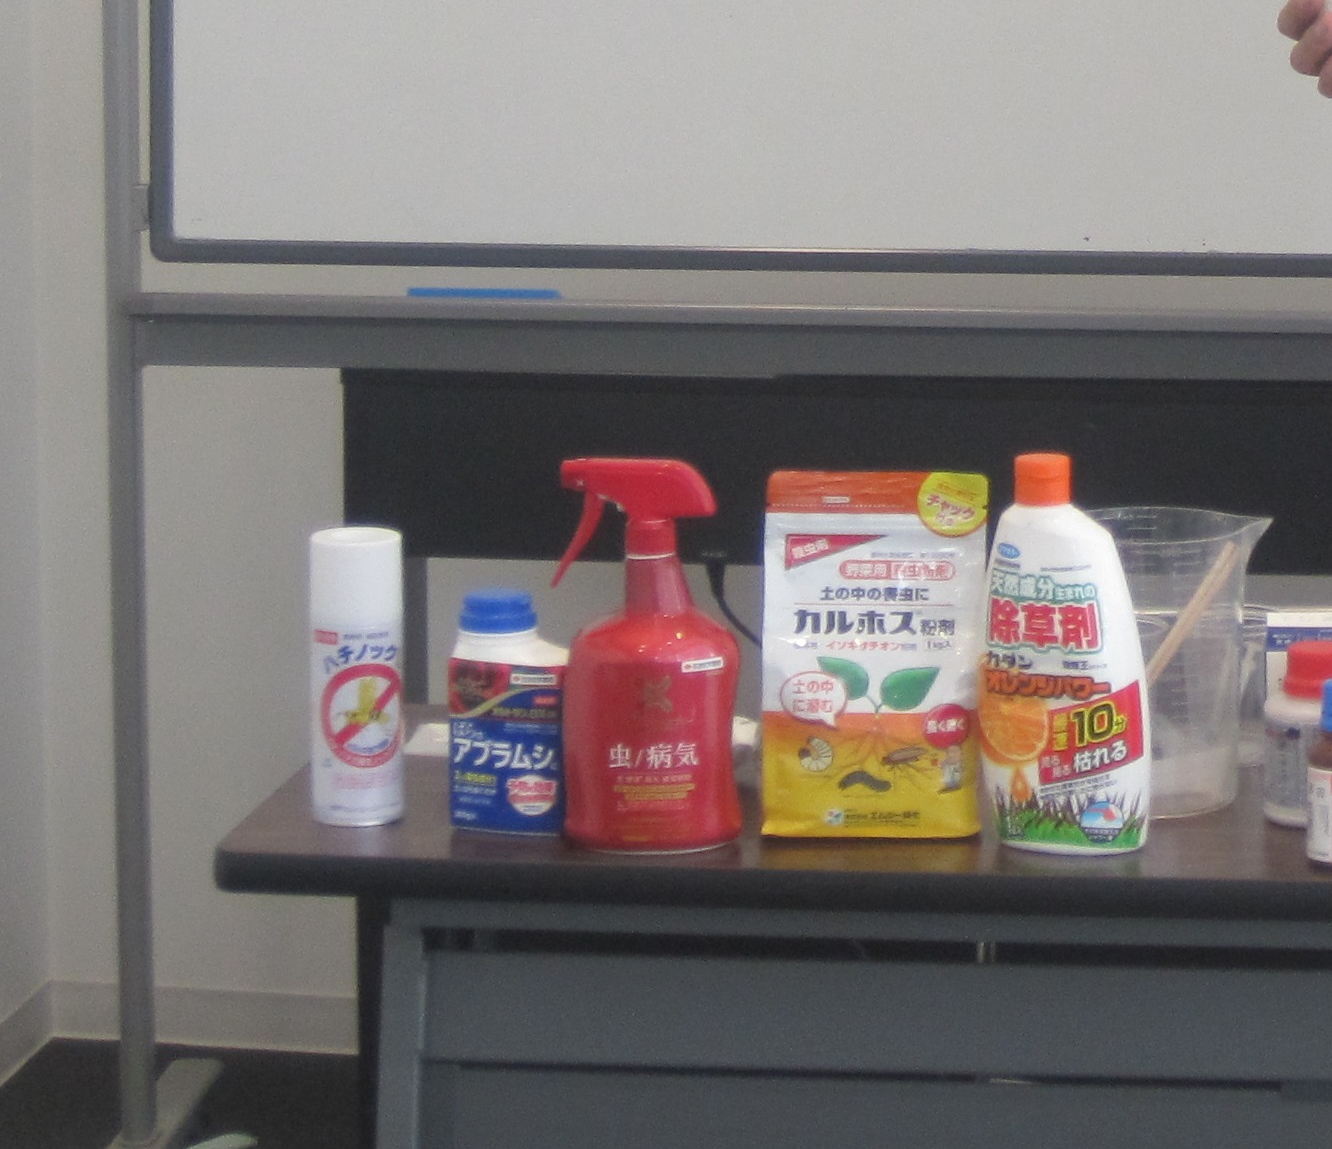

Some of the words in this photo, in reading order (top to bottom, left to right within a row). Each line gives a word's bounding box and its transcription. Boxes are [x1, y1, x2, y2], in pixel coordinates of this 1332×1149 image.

[820, 587, 928, 602] 土の中の害虫に
[793, 609, 916, 636] カルホス
[989, 598, 1099, 650] 除草剤
[323, 644, 398, 675] ハチノック
[792, 680, 834, 694] 土の中
[608, 743, 699, 770] 虫/病気
[1072, 740, 1128, 773] 枯れる
